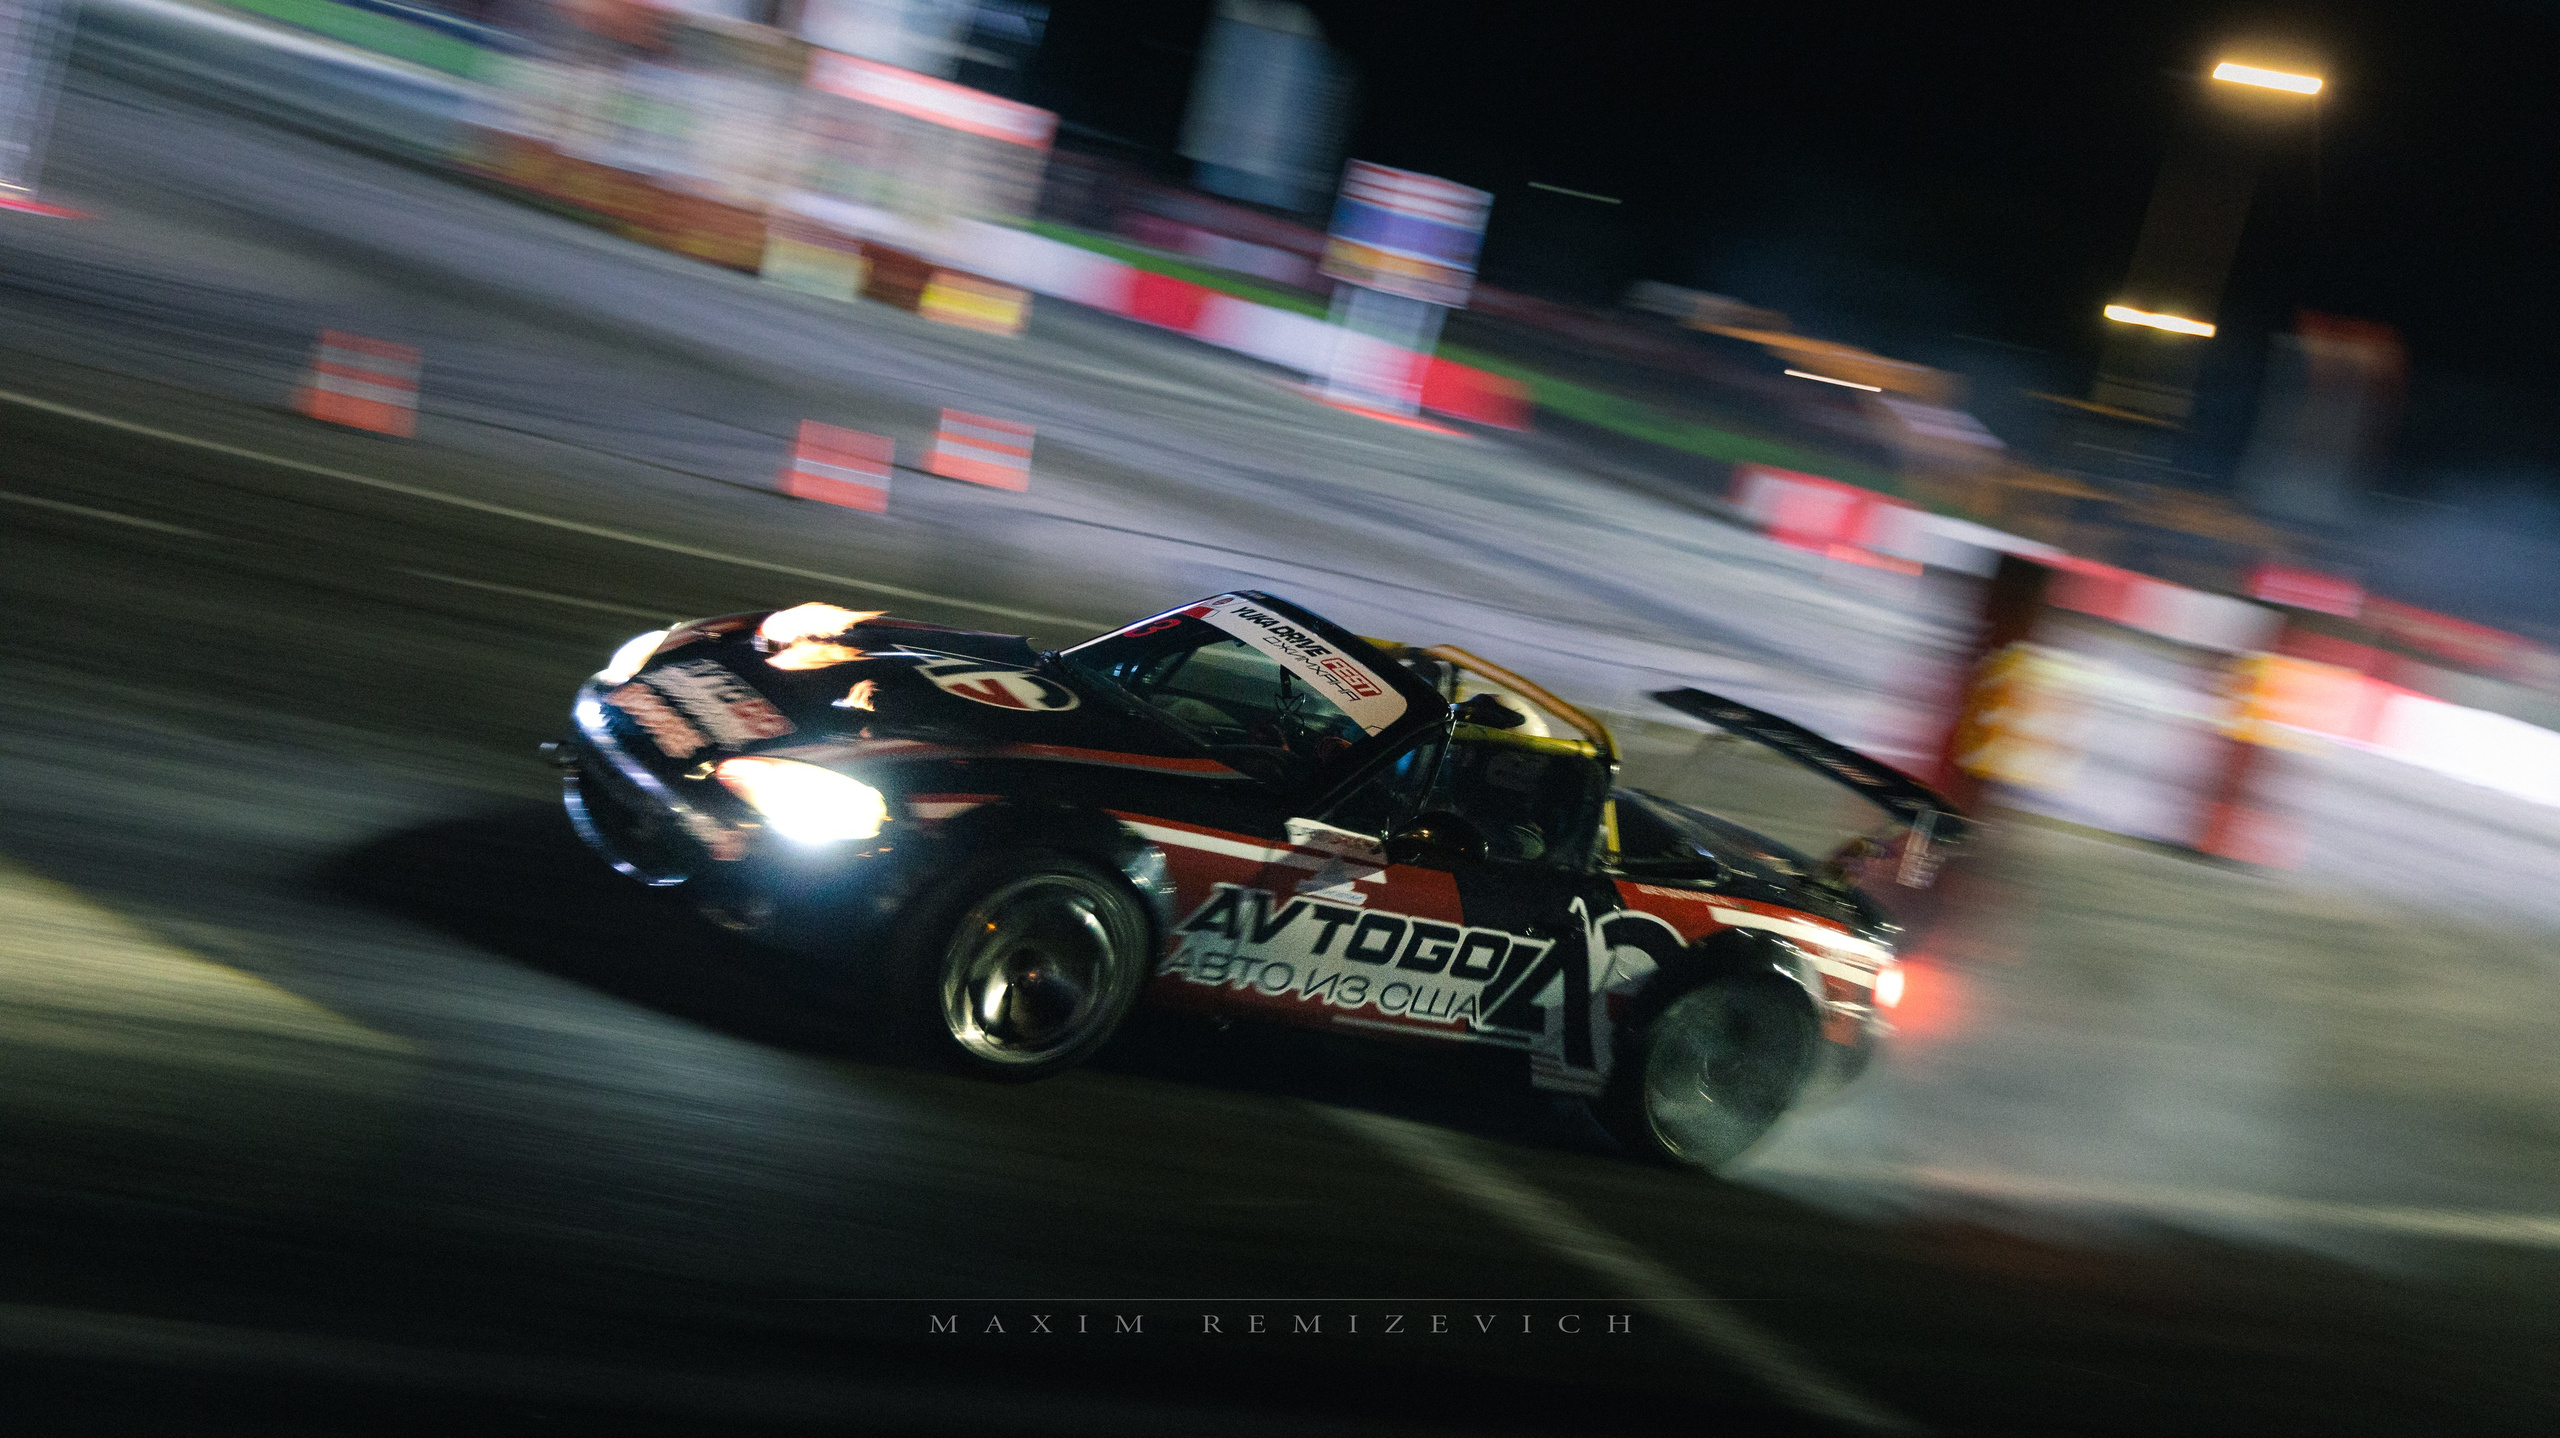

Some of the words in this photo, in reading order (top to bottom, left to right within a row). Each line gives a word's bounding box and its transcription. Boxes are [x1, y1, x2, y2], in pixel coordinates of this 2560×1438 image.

[1230, 606, 1280, 629] YUKA
[1268, 624, 1332, 658] DRIVE
[1320, 657, 1383, 698] FEST
[1262, 635, 1362, 702] ДЖИМХАНА
[1179, 885, 1513, 983] AVTOGO
[1158, 948, 1296, 993] АВТО
[1304, 968, 1371, 1005] ИЗ
[1379, 981, 1478, 1023] США
